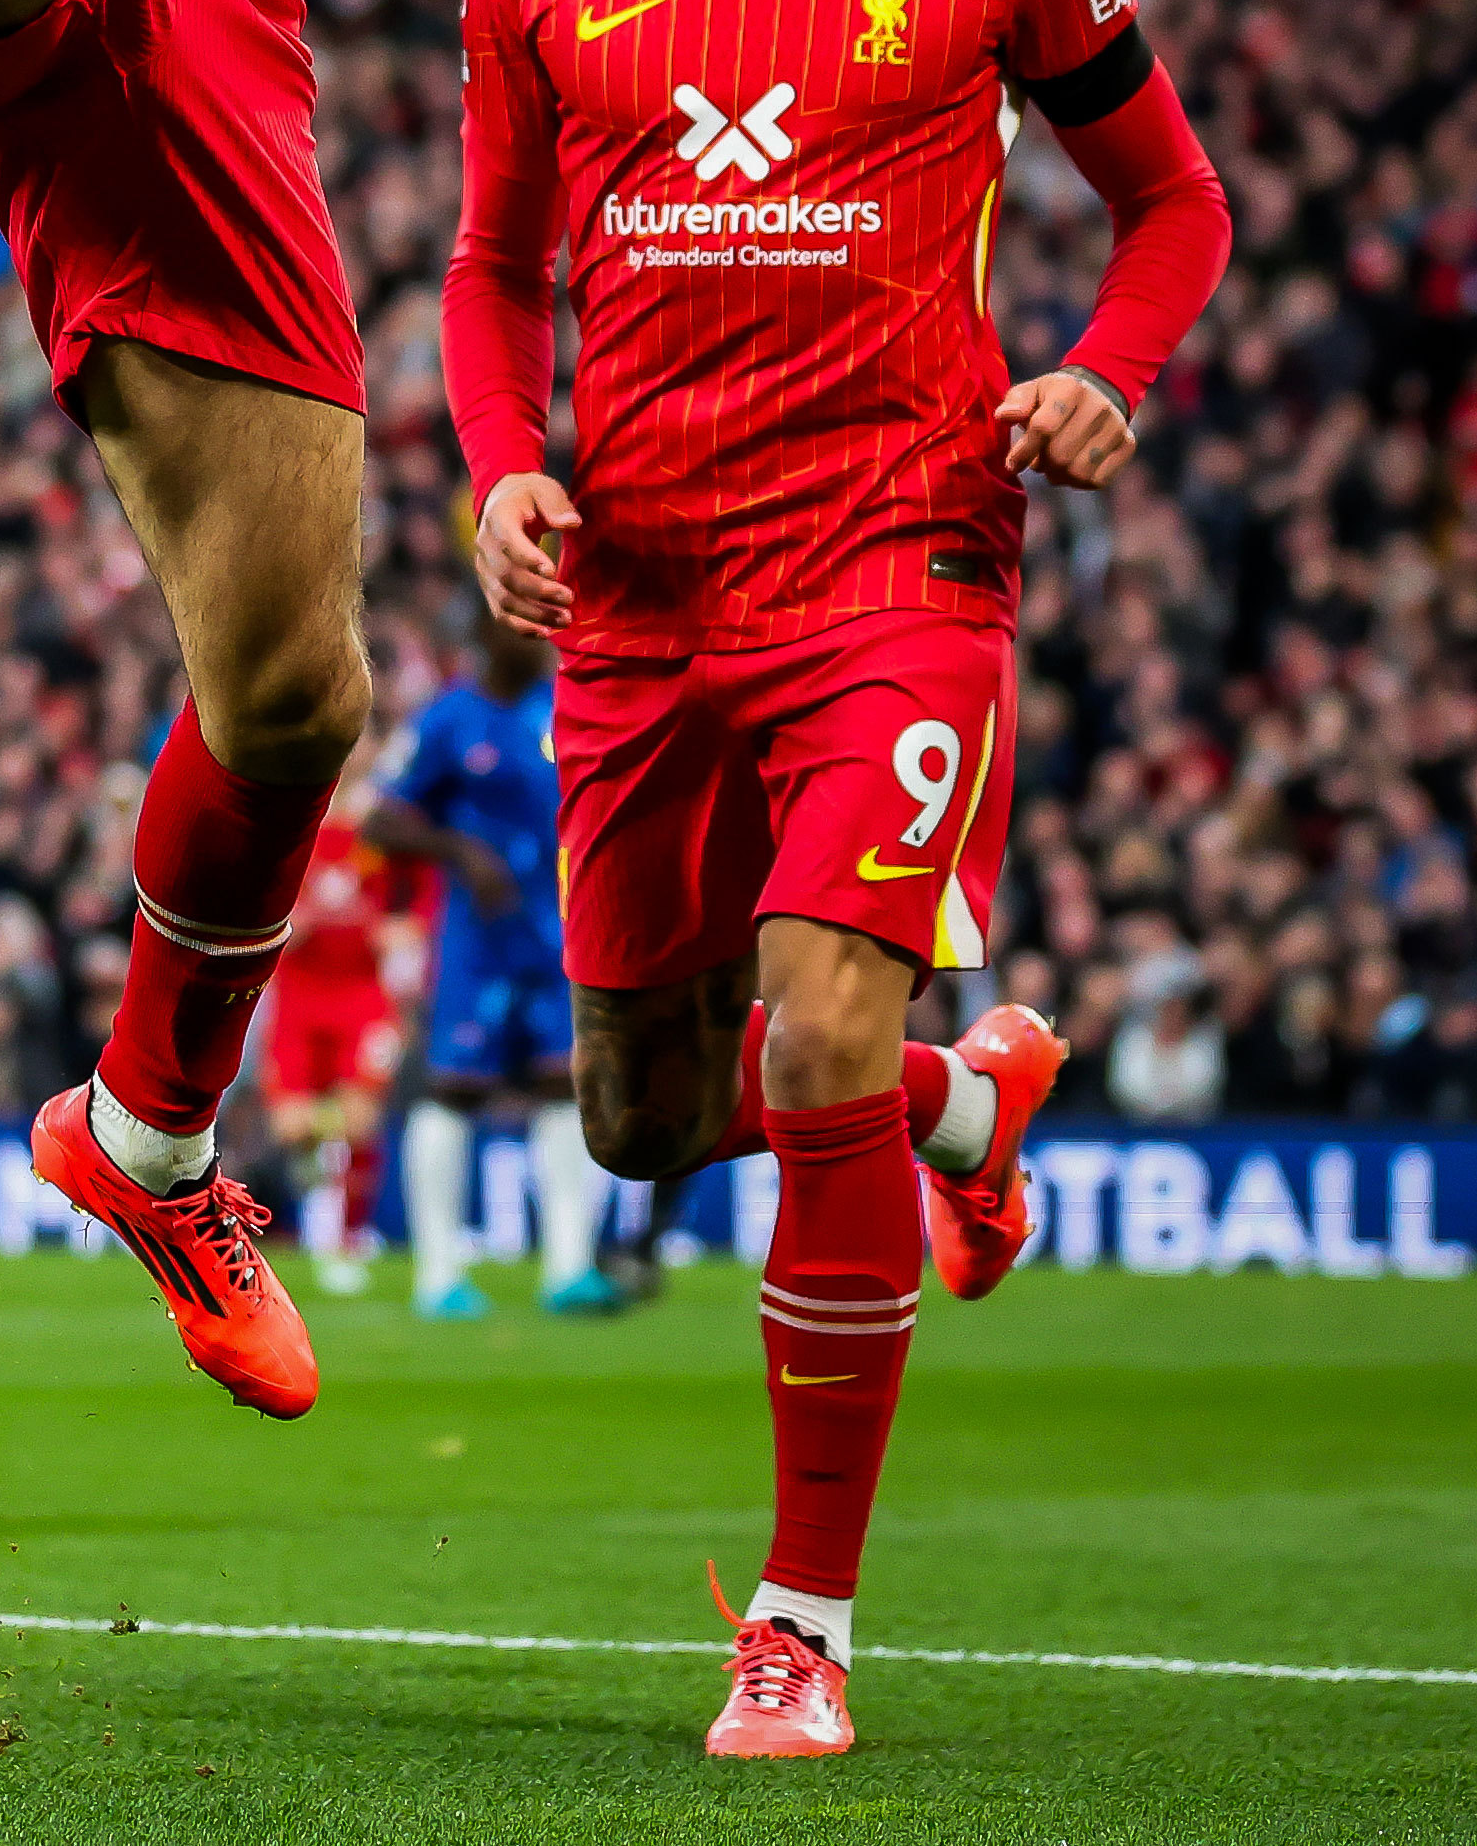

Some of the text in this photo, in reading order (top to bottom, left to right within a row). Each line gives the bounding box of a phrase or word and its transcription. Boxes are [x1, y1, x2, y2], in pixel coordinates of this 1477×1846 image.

[603, 193, 883, 236] futuremakers
[627, 244, 848, 272] by Standard Chartered
[892, 718, 962, 849] 9
